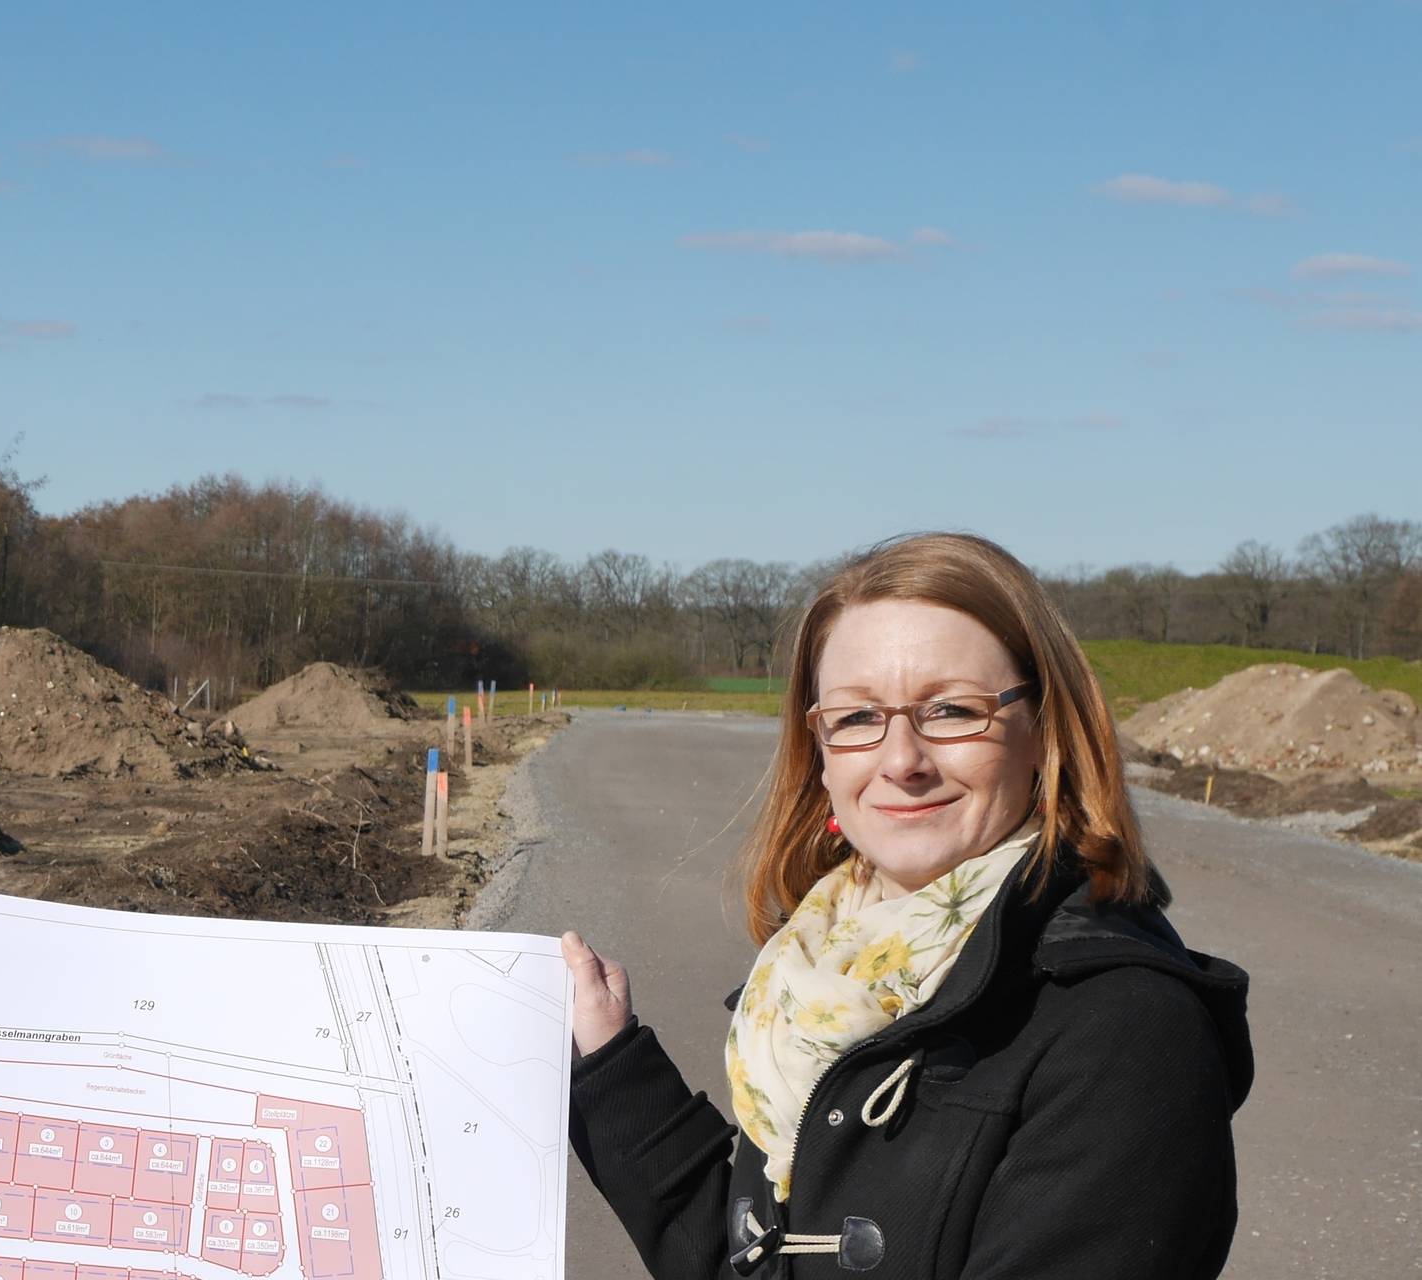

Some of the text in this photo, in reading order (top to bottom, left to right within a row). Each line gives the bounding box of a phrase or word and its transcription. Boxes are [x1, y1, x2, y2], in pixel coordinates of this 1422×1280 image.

[134, 1000, 155, 1010] 129
[356, 1012, 372, 1022] 27
[316, 1028, 330, 1038] 79
[464, 1122, 478, 1133] 21
[445, 1207, 460, 1220] 26
[394, 1228, 408, 1240] 91
